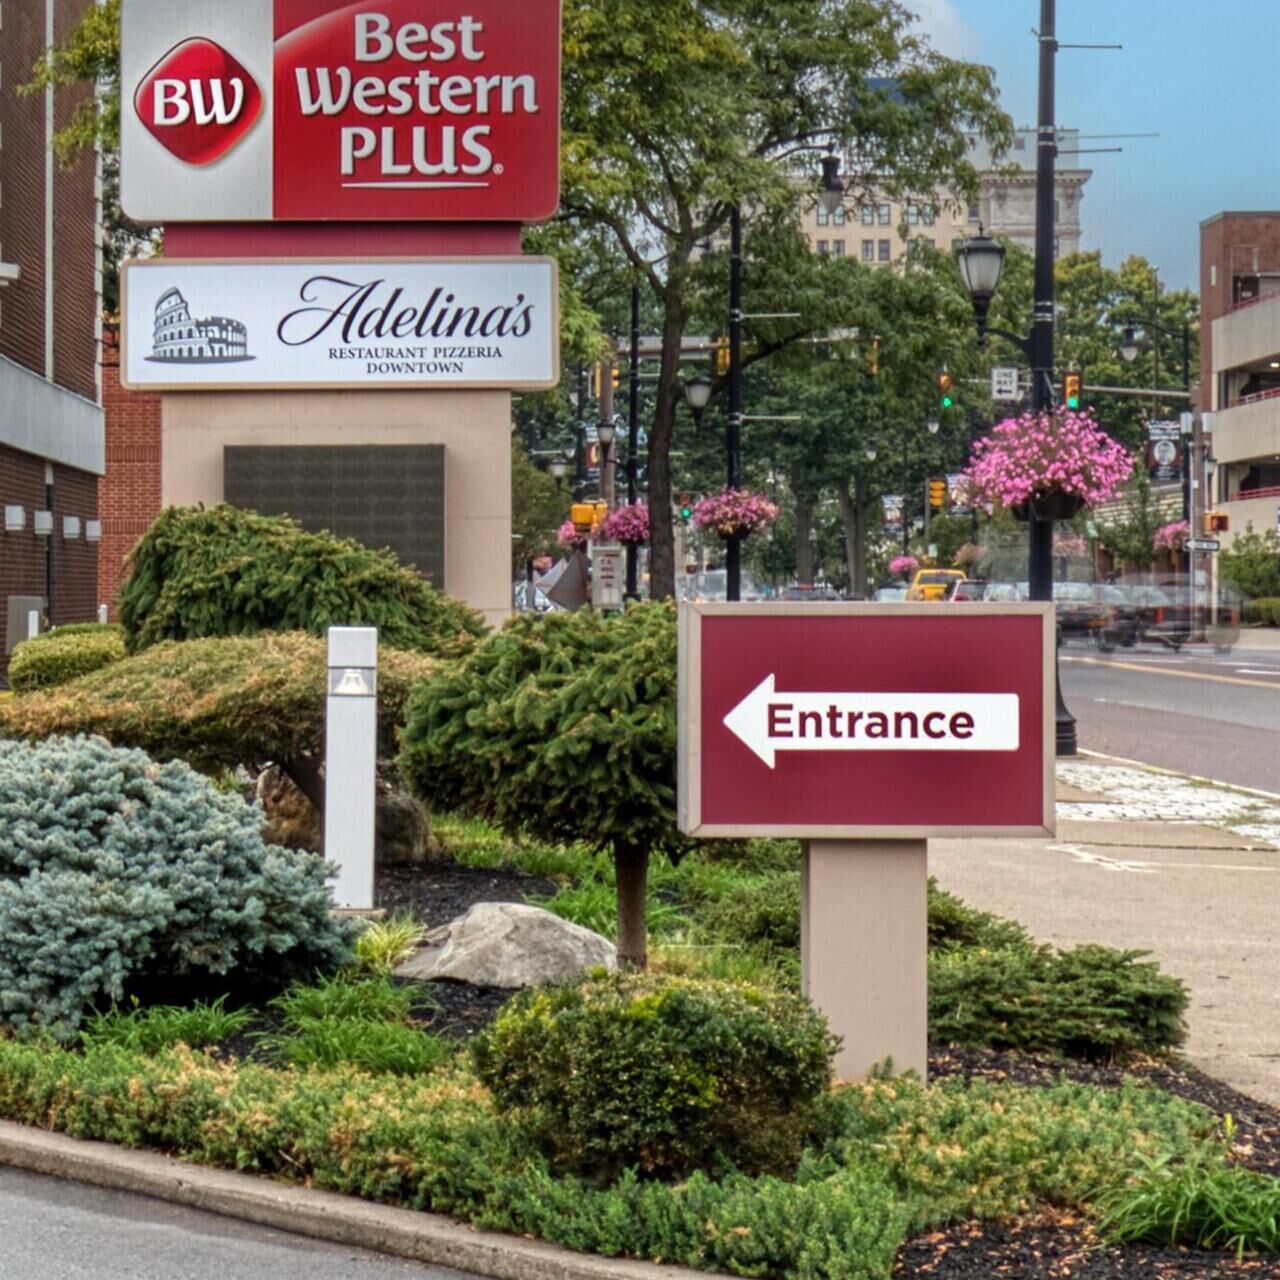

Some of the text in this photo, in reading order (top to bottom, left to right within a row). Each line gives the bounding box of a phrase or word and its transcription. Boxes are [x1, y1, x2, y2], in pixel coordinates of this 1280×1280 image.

[354, 12, 485, 63] Best
[152, 77, 245, 126] BW
[294, 66, 539, 116] Western
[276, 275, 535, 347] Adelina's
[328, 347, 503, 360] RESTAURANT PIZZERIA
[366, 361, 465, 375] DOWNTOWN
[767, 702, 976, 739] Entrance
